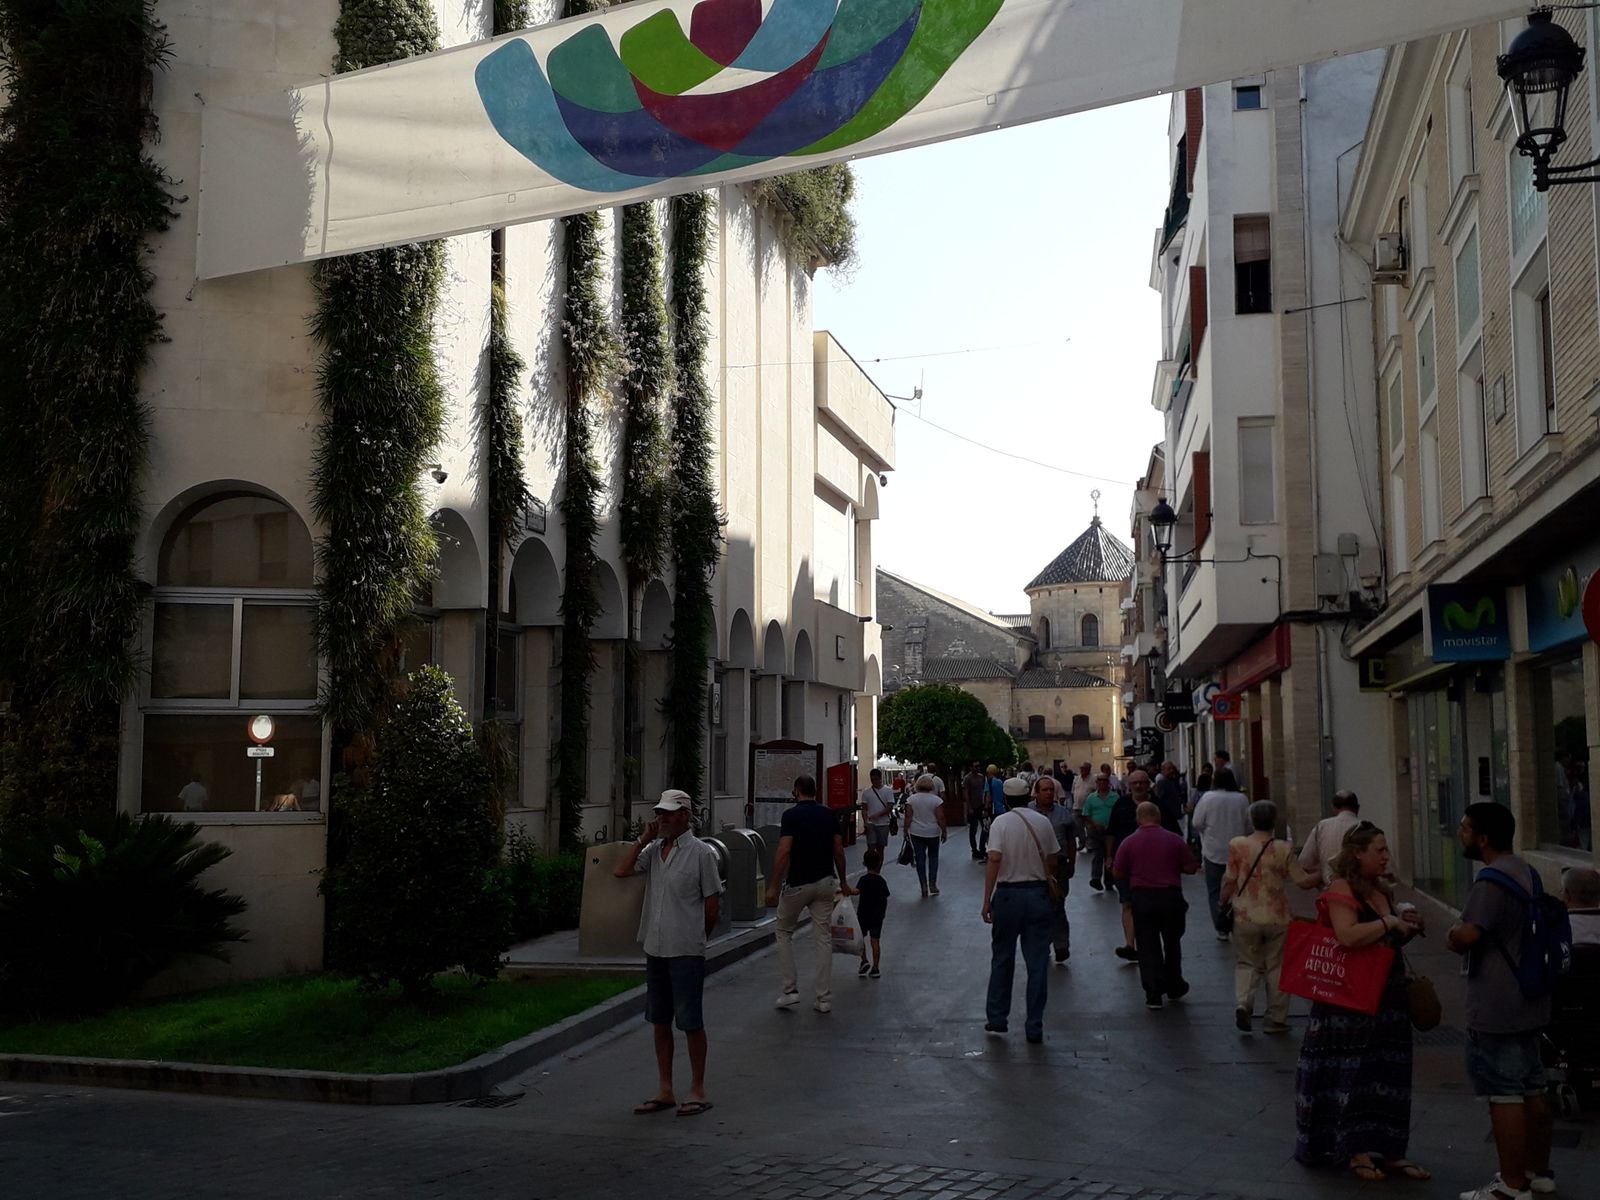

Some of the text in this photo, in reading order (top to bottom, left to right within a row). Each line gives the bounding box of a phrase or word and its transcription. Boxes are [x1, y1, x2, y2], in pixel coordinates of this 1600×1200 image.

[1443, 635, 1498, 648] movistar
[1311, 944, 1333, 958] LLENA
[1305, 958, 1345, 978] APOYO
